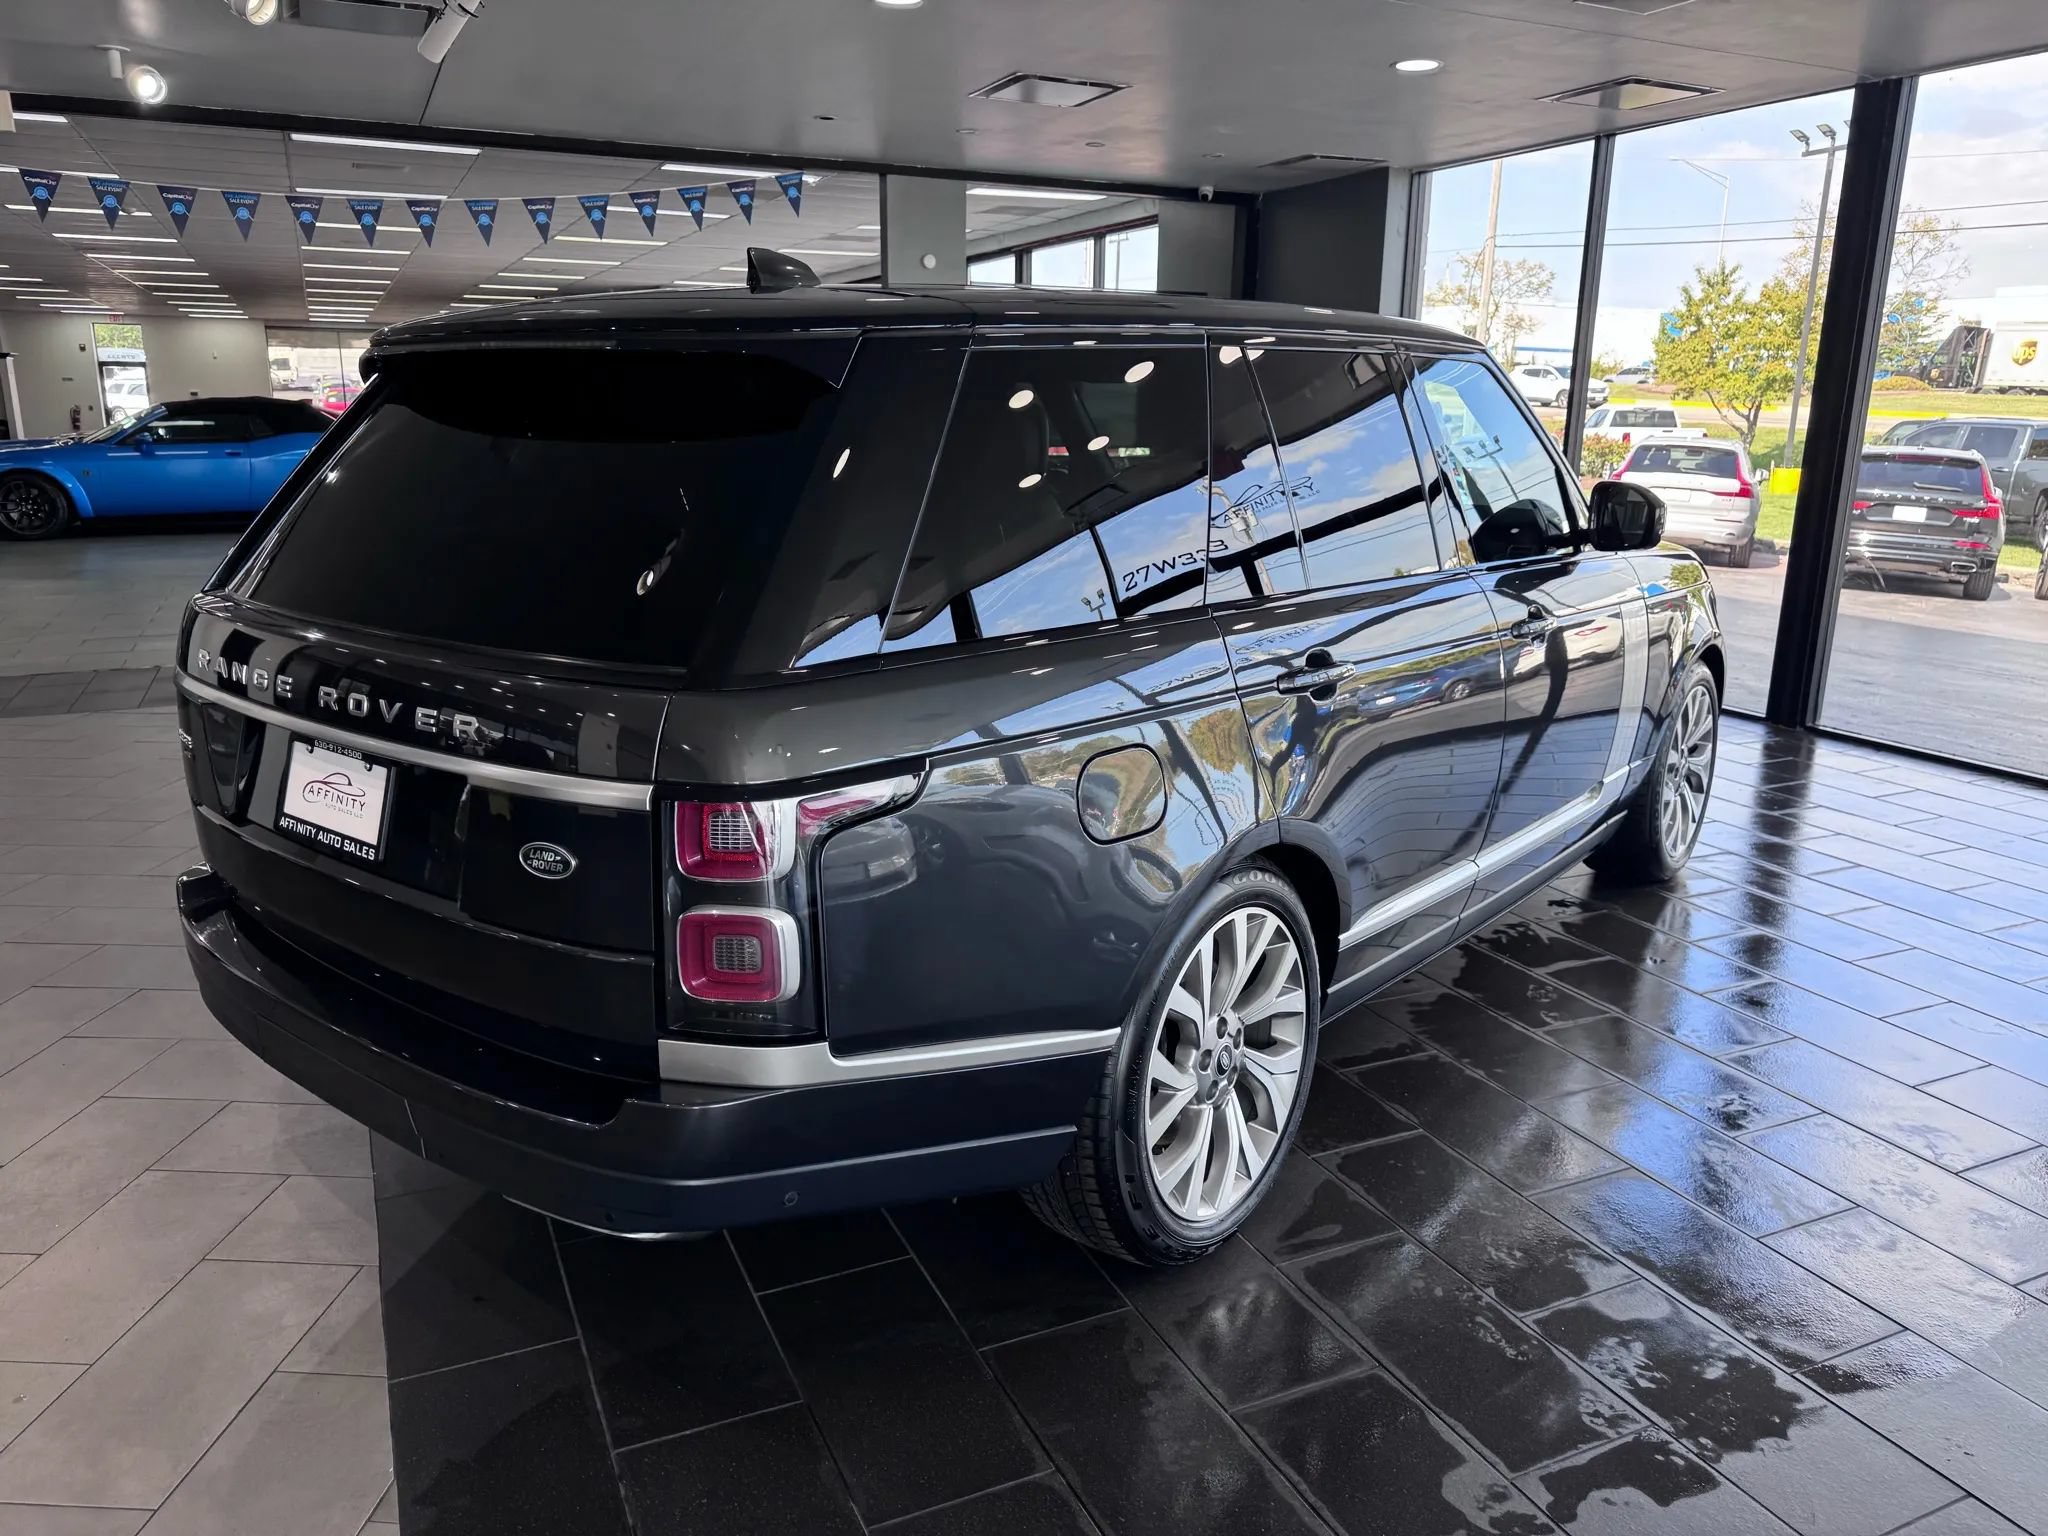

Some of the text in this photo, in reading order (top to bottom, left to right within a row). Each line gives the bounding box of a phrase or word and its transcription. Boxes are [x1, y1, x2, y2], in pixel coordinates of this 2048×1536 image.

[199, 649, 478, 741] RANGE ROVER
[314, 740, 362, 760] 630-912-4500
[308, 785, 366, 811] AFFINITY
[279, 817, 375, 861] AFFINITY AUTO SALES
